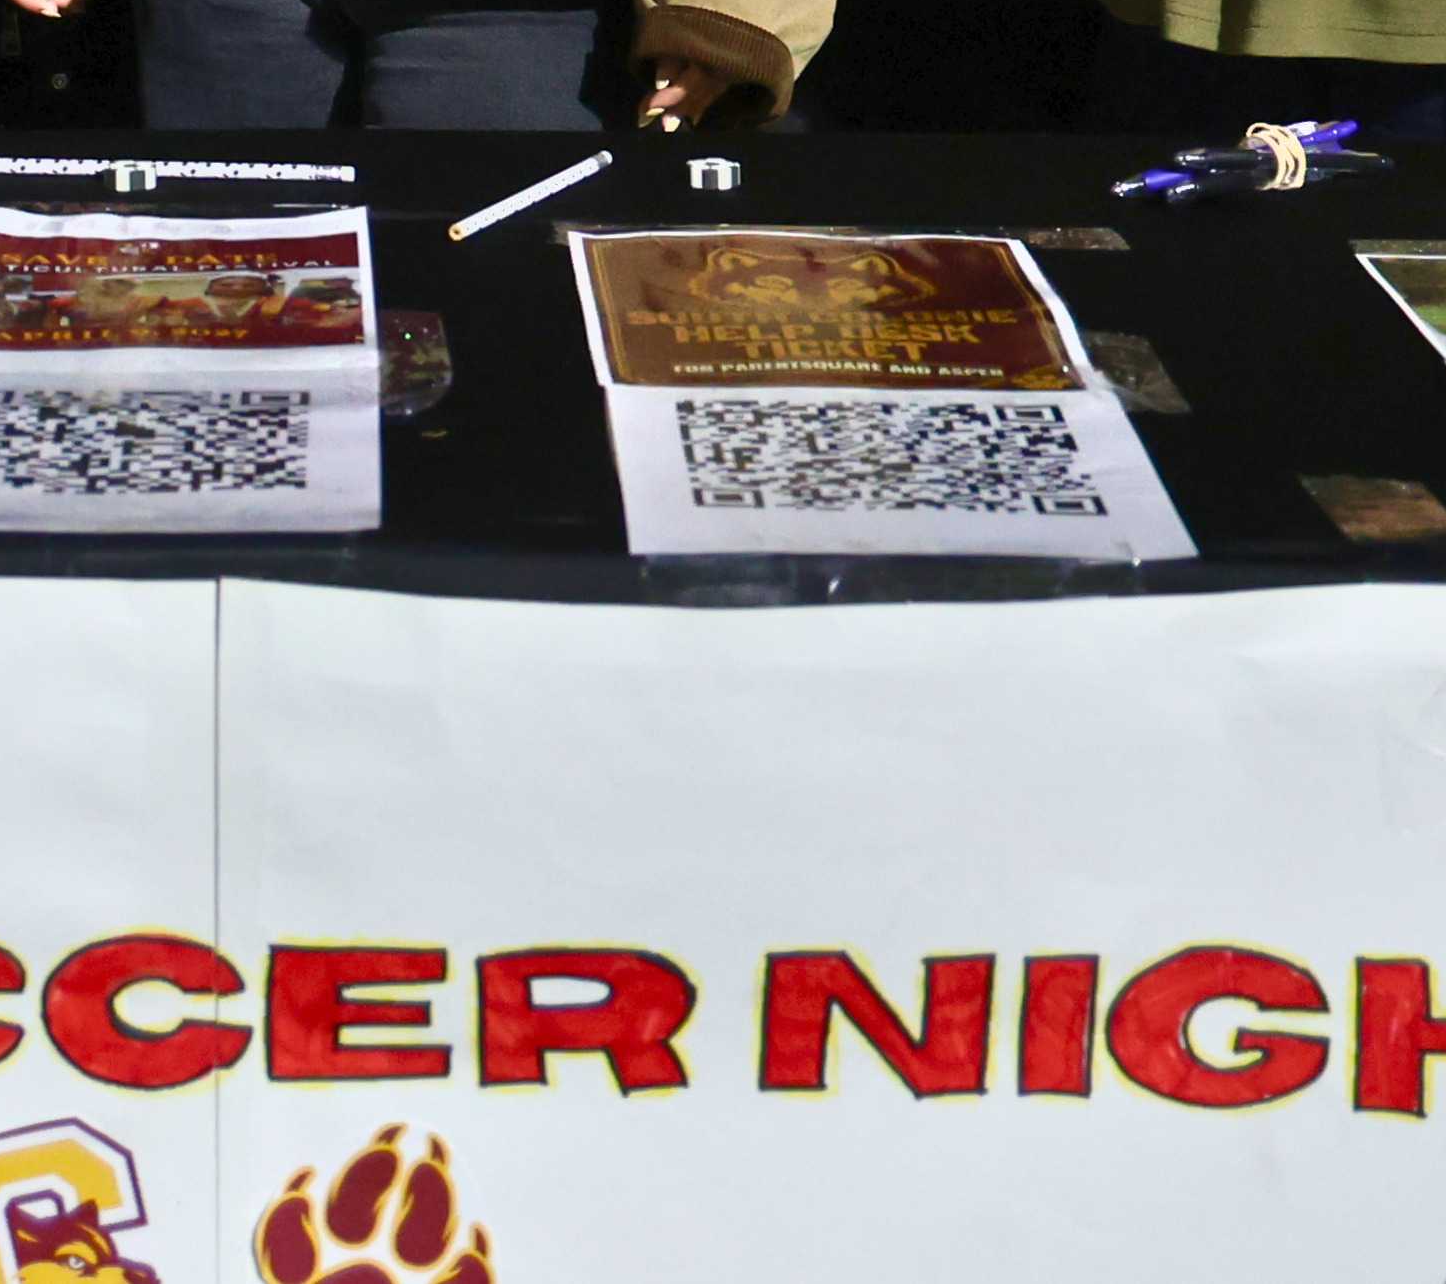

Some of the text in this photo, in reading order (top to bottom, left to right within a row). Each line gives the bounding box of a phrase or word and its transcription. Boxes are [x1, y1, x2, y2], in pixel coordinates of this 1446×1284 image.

[674, 324, 982, 344] HELP DESK
[734, 340, 928, 362] TICKET
[889, 364, 932, 375] AND
